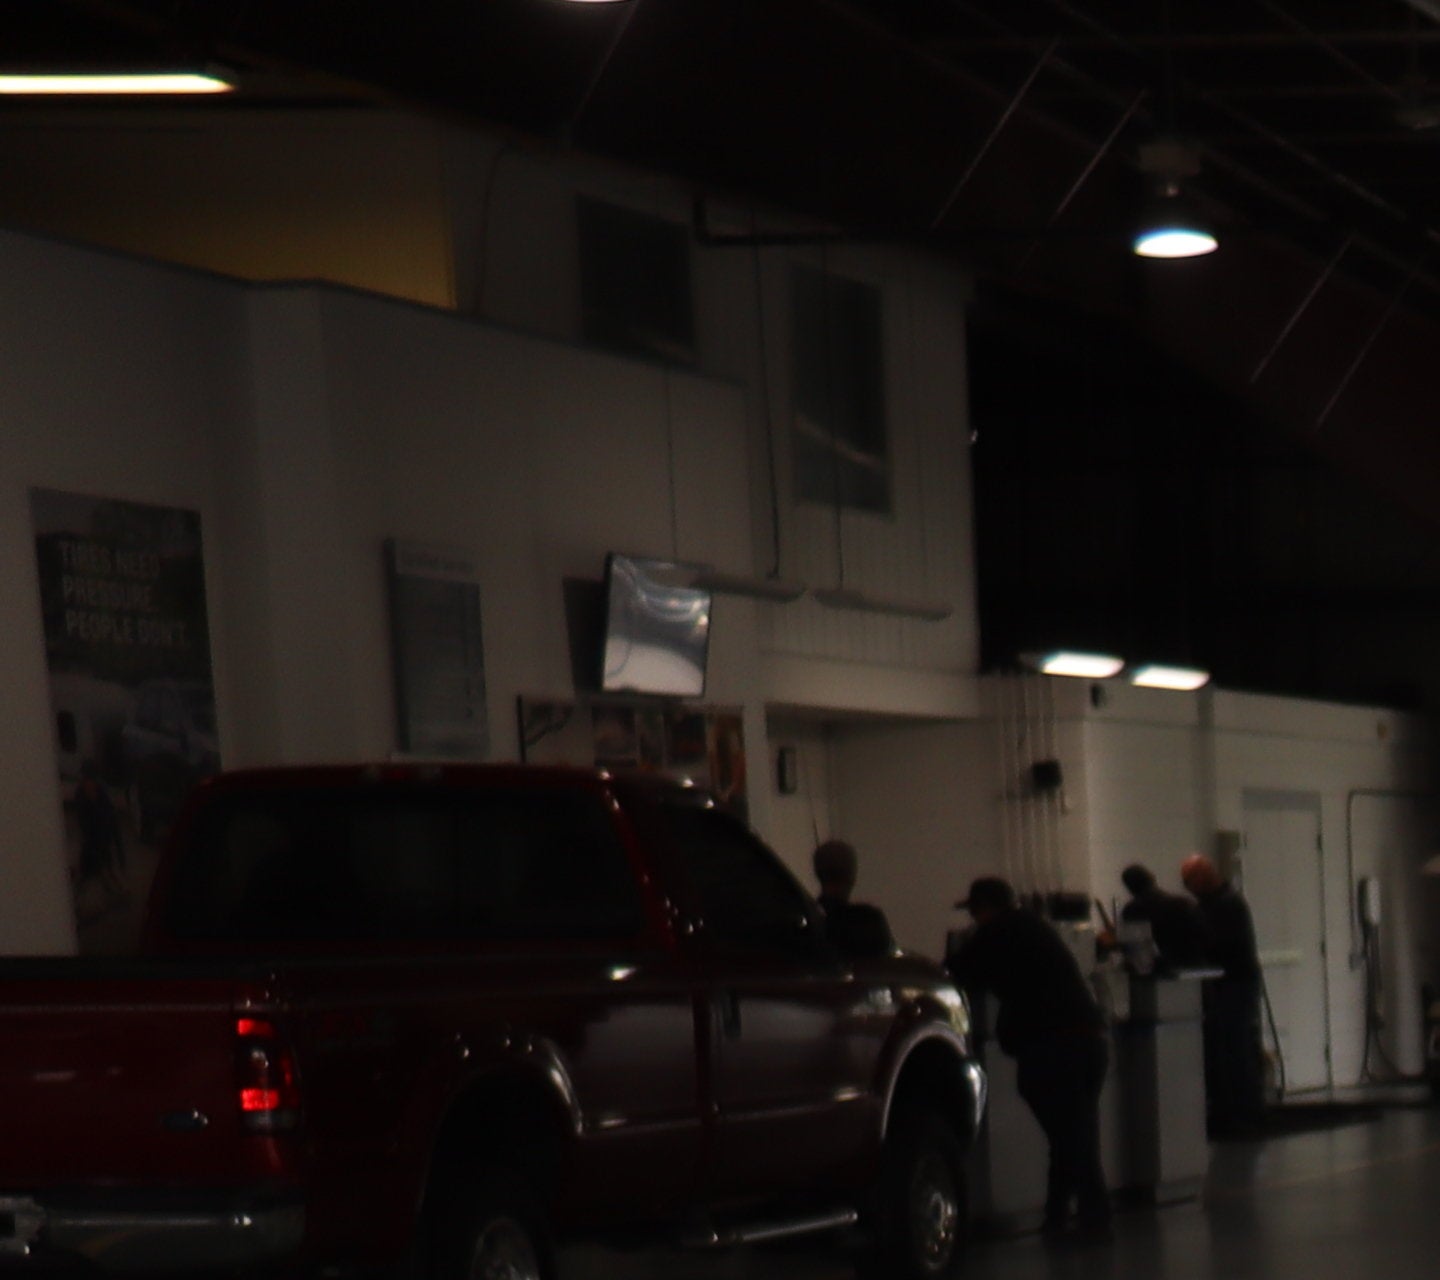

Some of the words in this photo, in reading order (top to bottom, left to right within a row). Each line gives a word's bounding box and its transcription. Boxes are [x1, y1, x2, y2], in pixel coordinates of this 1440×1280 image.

[58, 540, 112, 576] TIRES
[115, 549, 160, 580] NEED
[65, 608, 134, 646] PEOPLE
